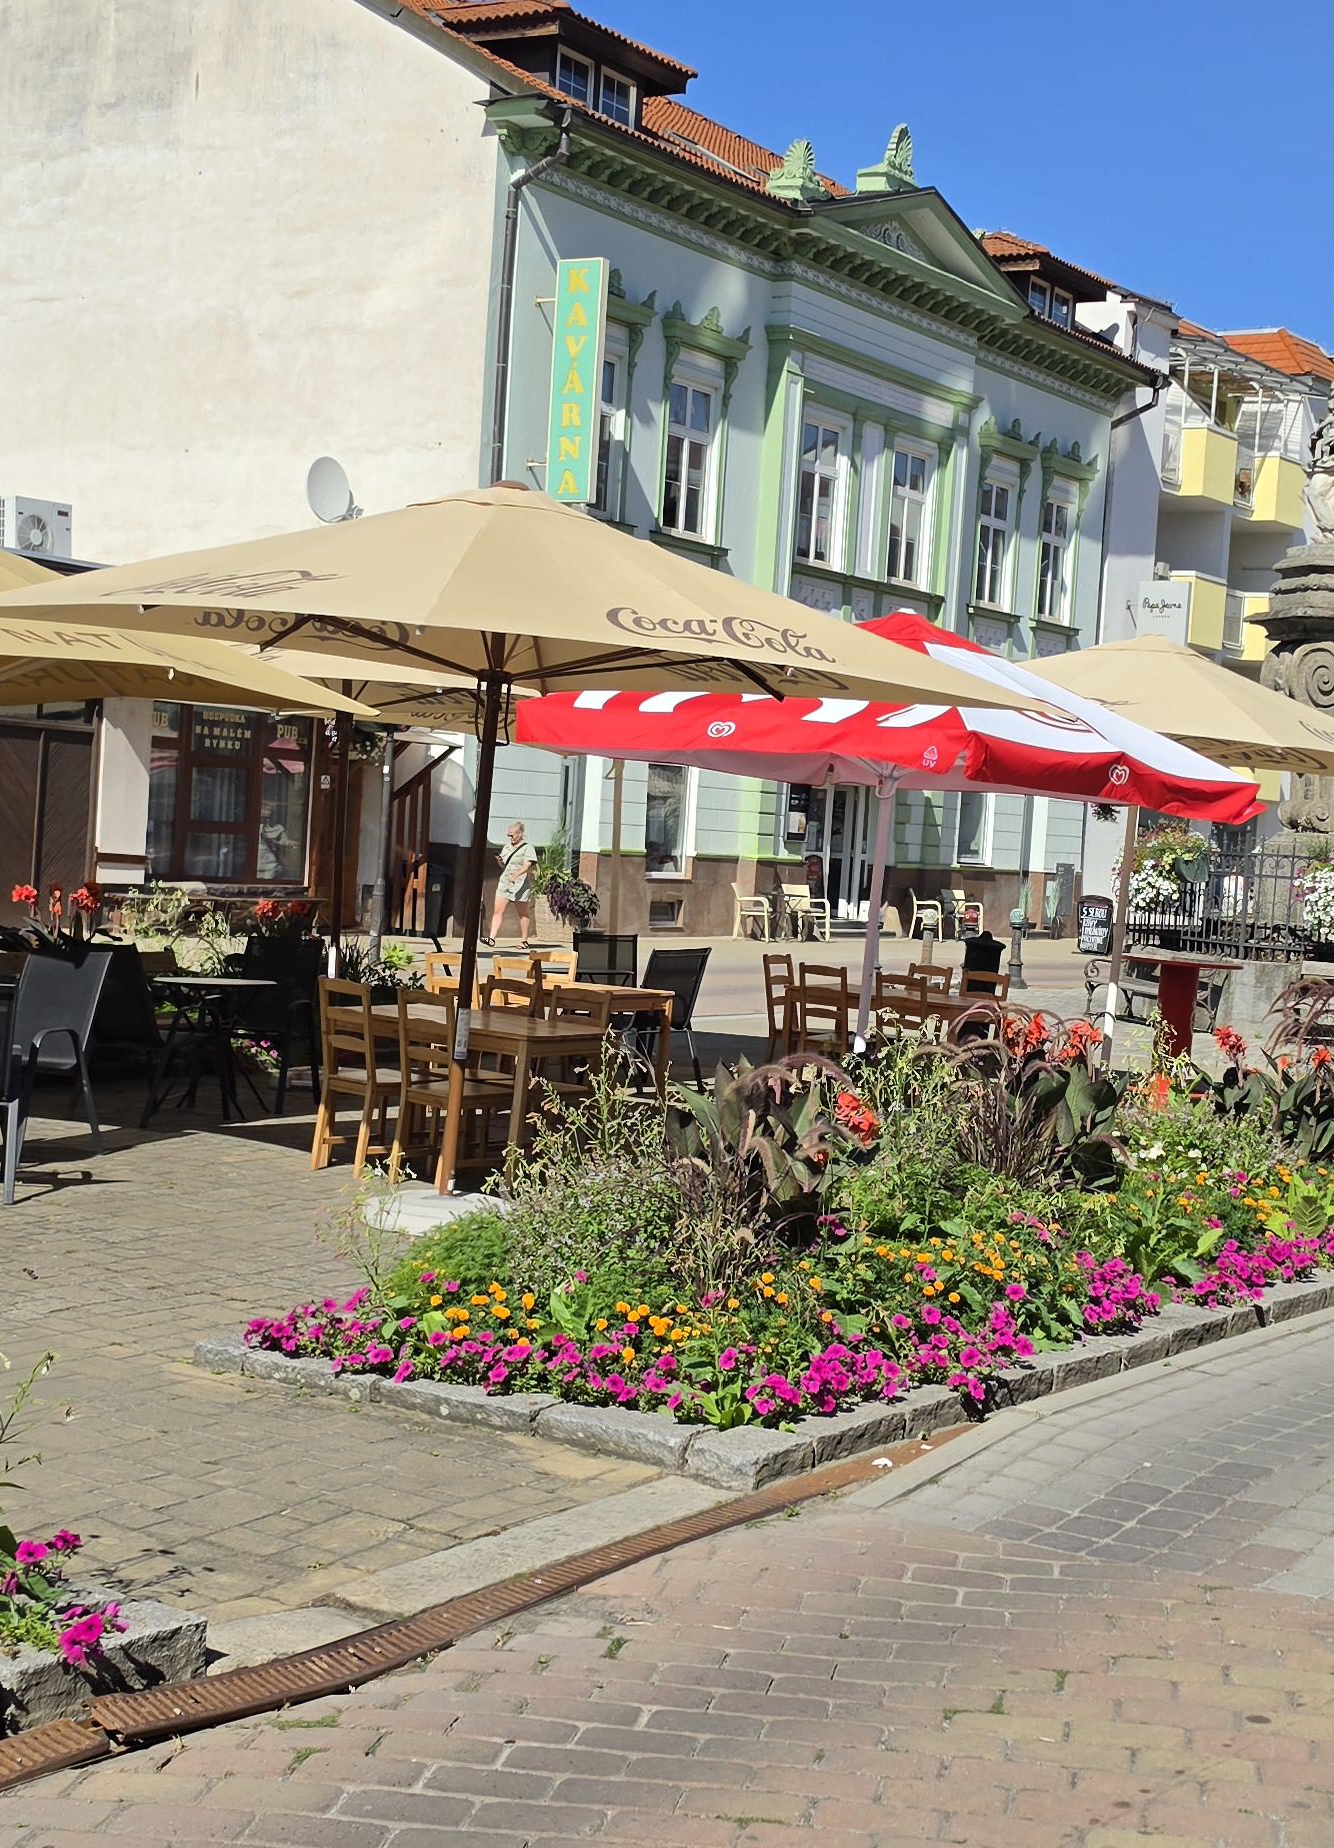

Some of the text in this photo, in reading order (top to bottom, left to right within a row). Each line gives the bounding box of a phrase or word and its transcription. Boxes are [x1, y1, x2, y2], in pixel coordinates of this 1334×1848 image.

[556, 268, 591, 496] KAVÁRNA
[605, 607, 836, 664] Coca-Cola
[152, 711, 169, 726] UB
[195, 725, 210, 736] NA
[276, 724, 299, 740] PUB
[922, 758, 937, 768] UV
